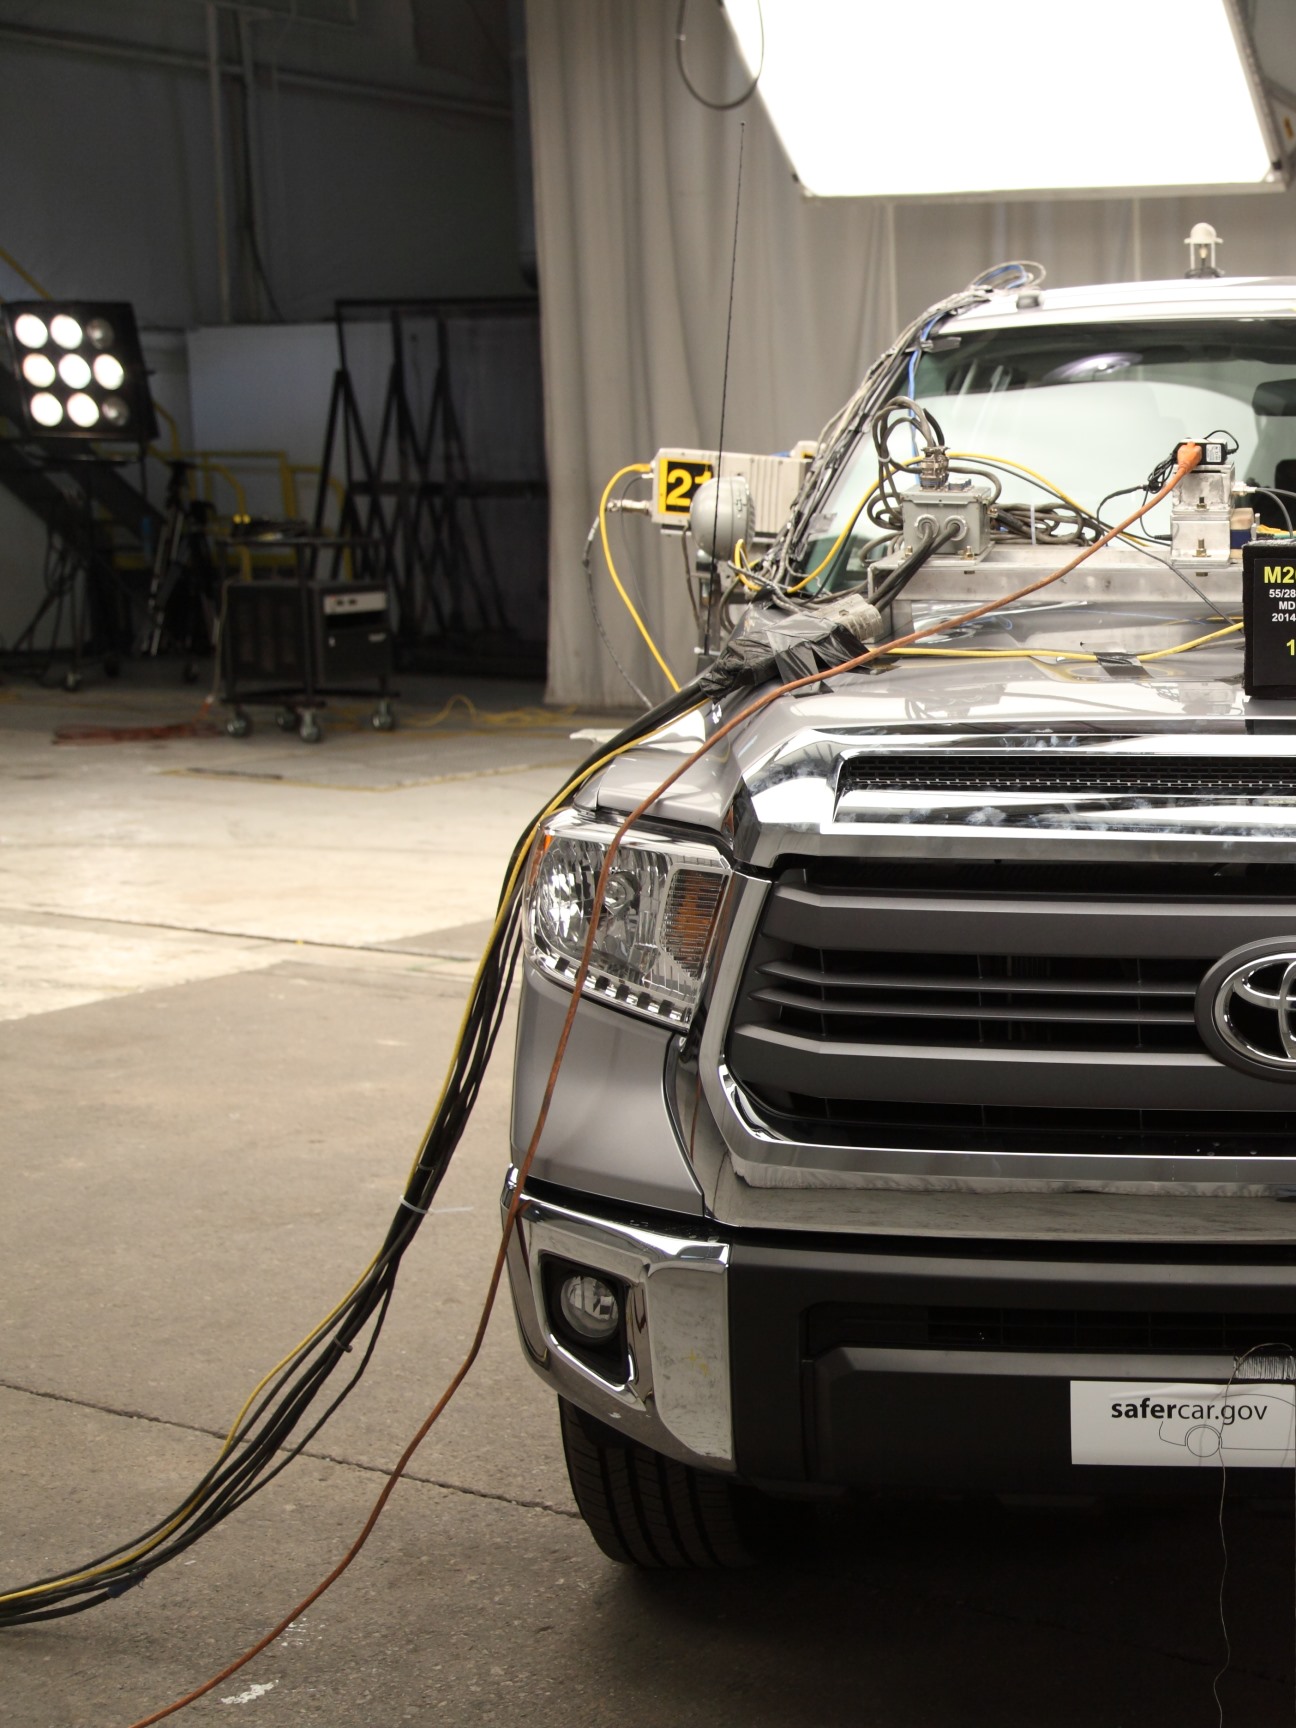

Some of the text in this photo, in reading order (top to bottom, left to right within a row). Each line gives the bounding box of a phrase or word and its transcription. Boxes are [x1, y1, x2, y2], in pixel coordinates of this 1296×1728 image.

[1269, 589, 1296, 599] 55/28
[1271, 613, 1296, 622] 2014
[1111, 1398, 1268, 1425] safercar.gov
